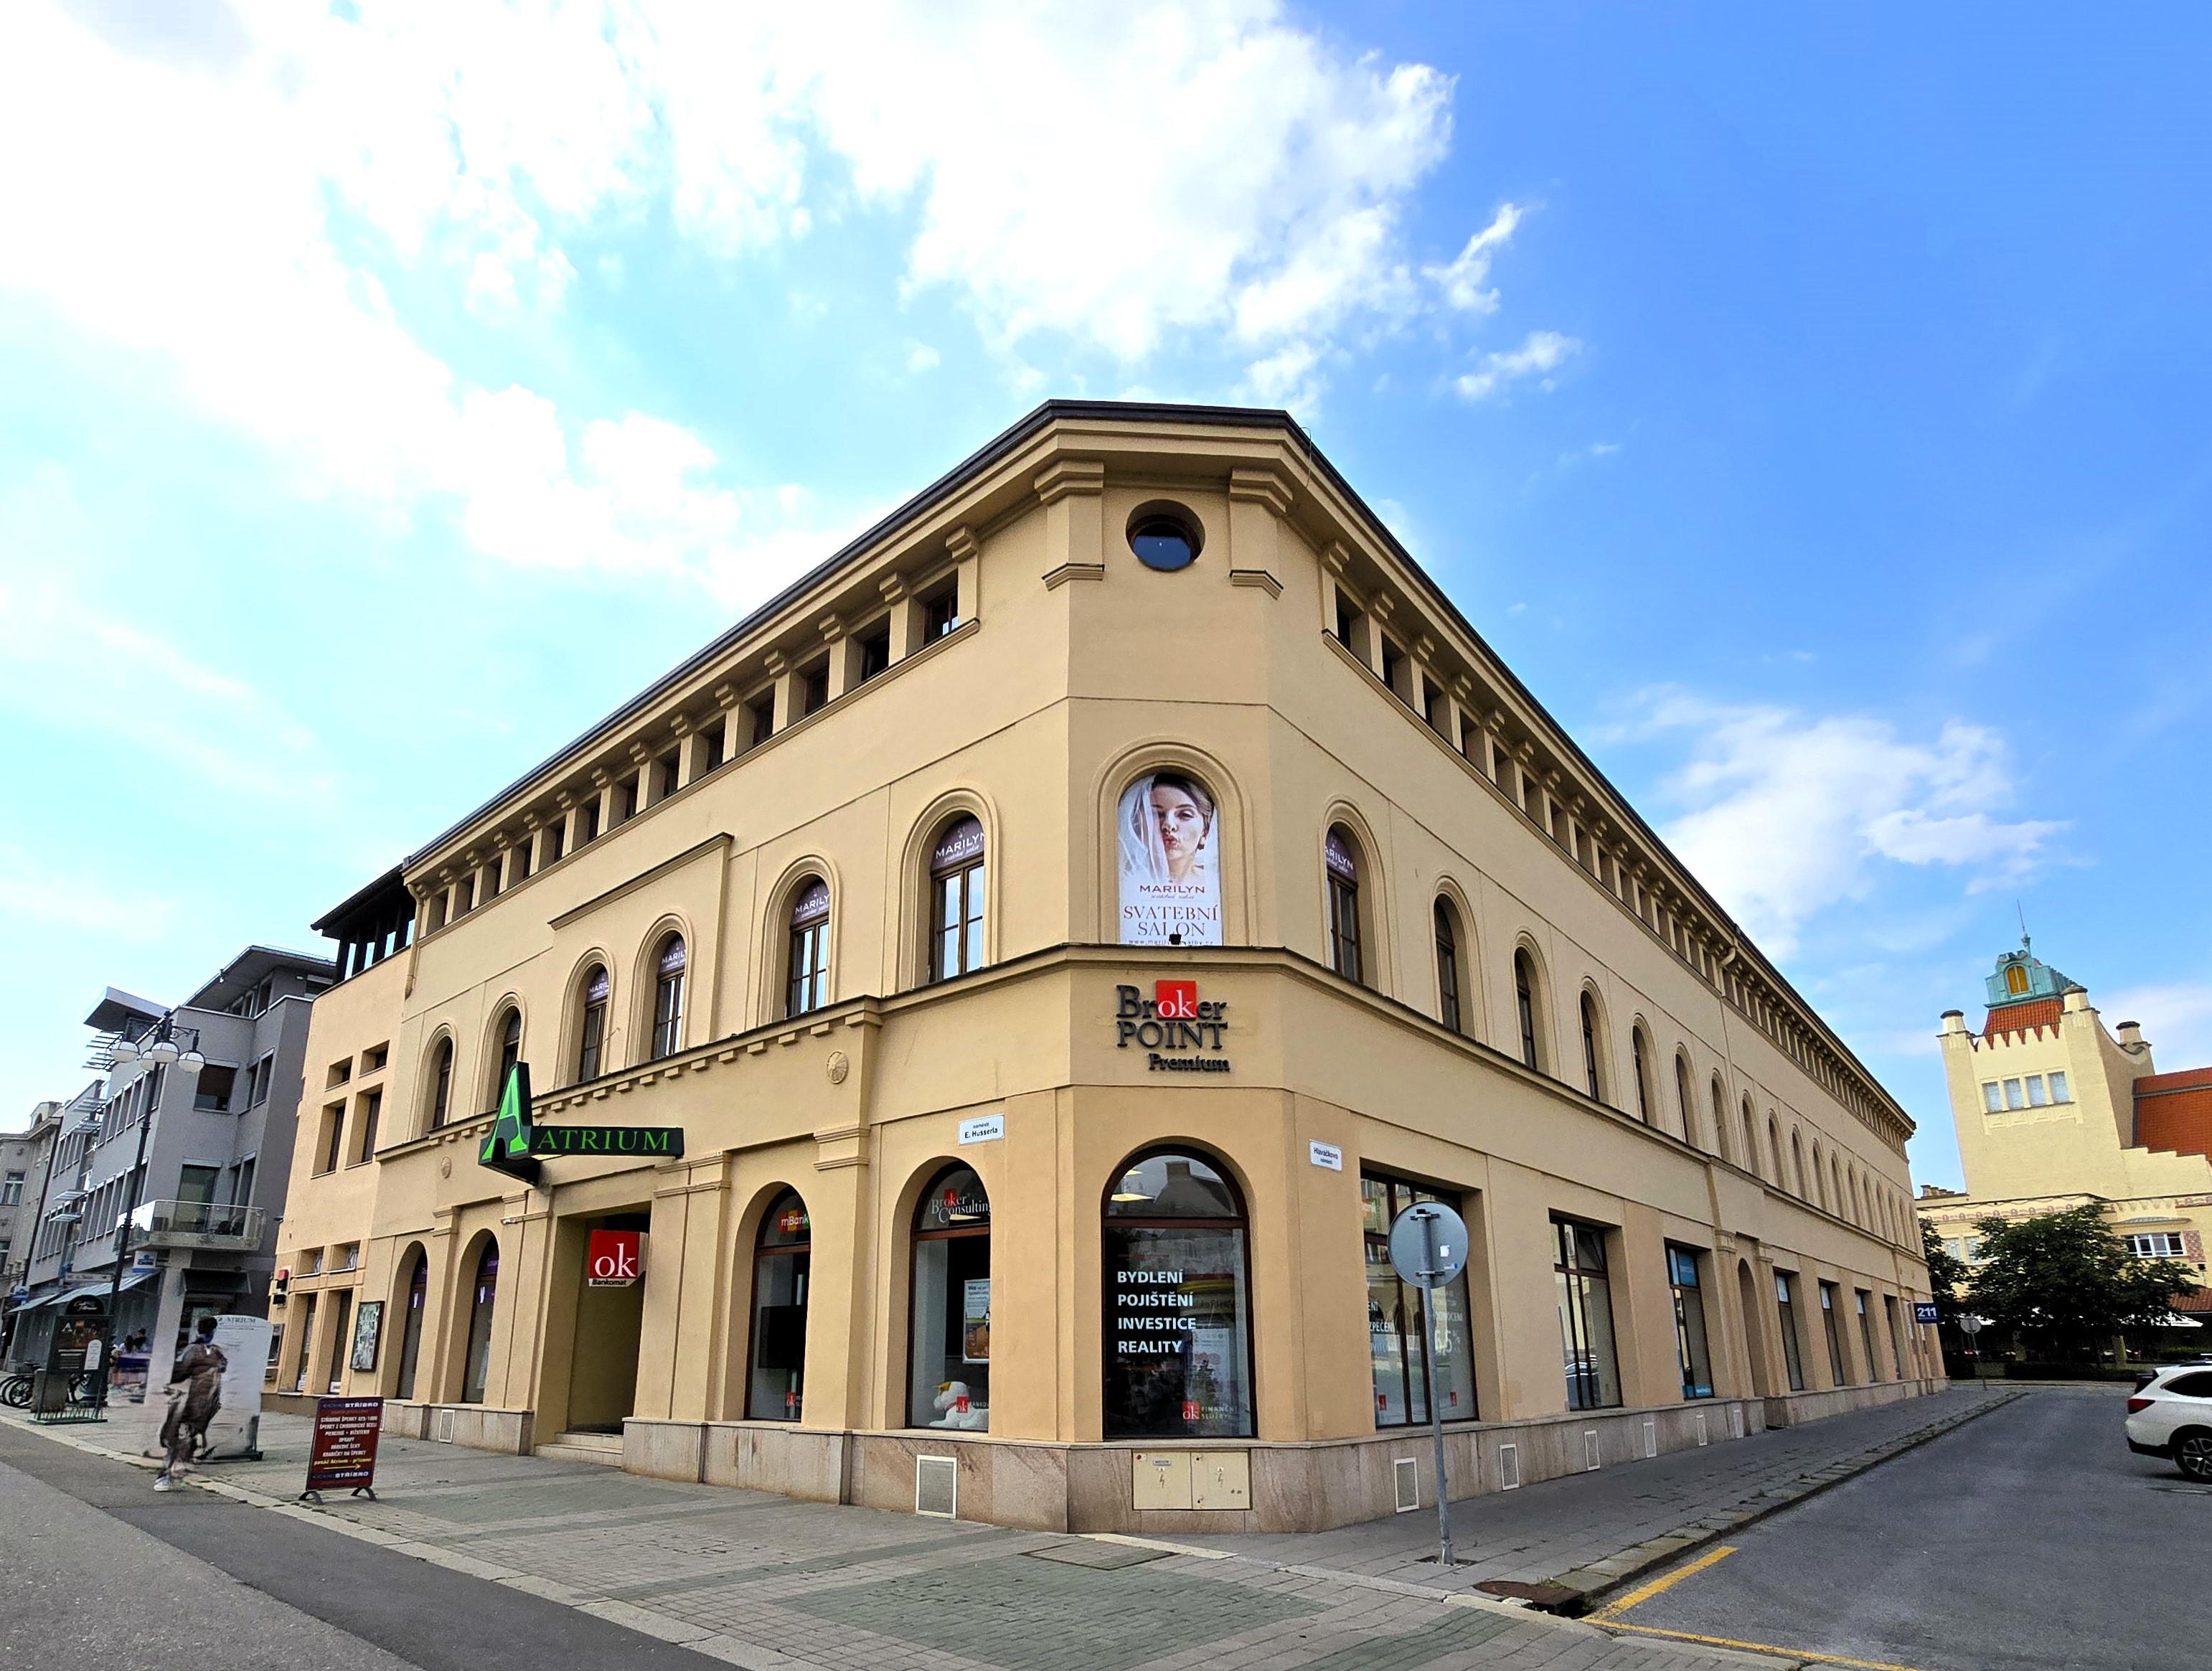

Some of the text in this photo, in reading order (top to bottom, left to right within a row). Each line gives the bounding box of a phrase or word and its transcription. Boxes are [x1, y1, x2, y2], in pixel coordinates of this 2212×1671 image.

[1139, 885, 1205, 893] MARILYN
[795, 894, 830, 915] MARILY
[1124, 904, 1218, 921] SVATEBNÍ
[1137, 921, 1205, 936] SALON
[1116, 985, 1228, 1020] Broker
[1116, 1021, 1228, 1049] POINT
[1149, 1053, 1230, 1071] Premium
[481, 1067, 528, 1160] A
[537, 1129, 670, 1151] ATRIUM
[972, 1127, 998, 1137] Husserla
[931, 1192, 967, 1214] Broker
[781, 1213, 809, 1226] mBank
[595, 1243, 636, 1277] ok
[1117, 1268, 1183, 1284] BYDLENÍ
[1118, 1291, 1193, 1307] POJIŠTĚNÍ
[1917, 1307, 1936, 1317] 211
[1118, 1317, 1197, 1329] INVESTICE
[1118, 1341, 1182, 1353] REALITY
[1183, 1406, 1199, 1420] ok
